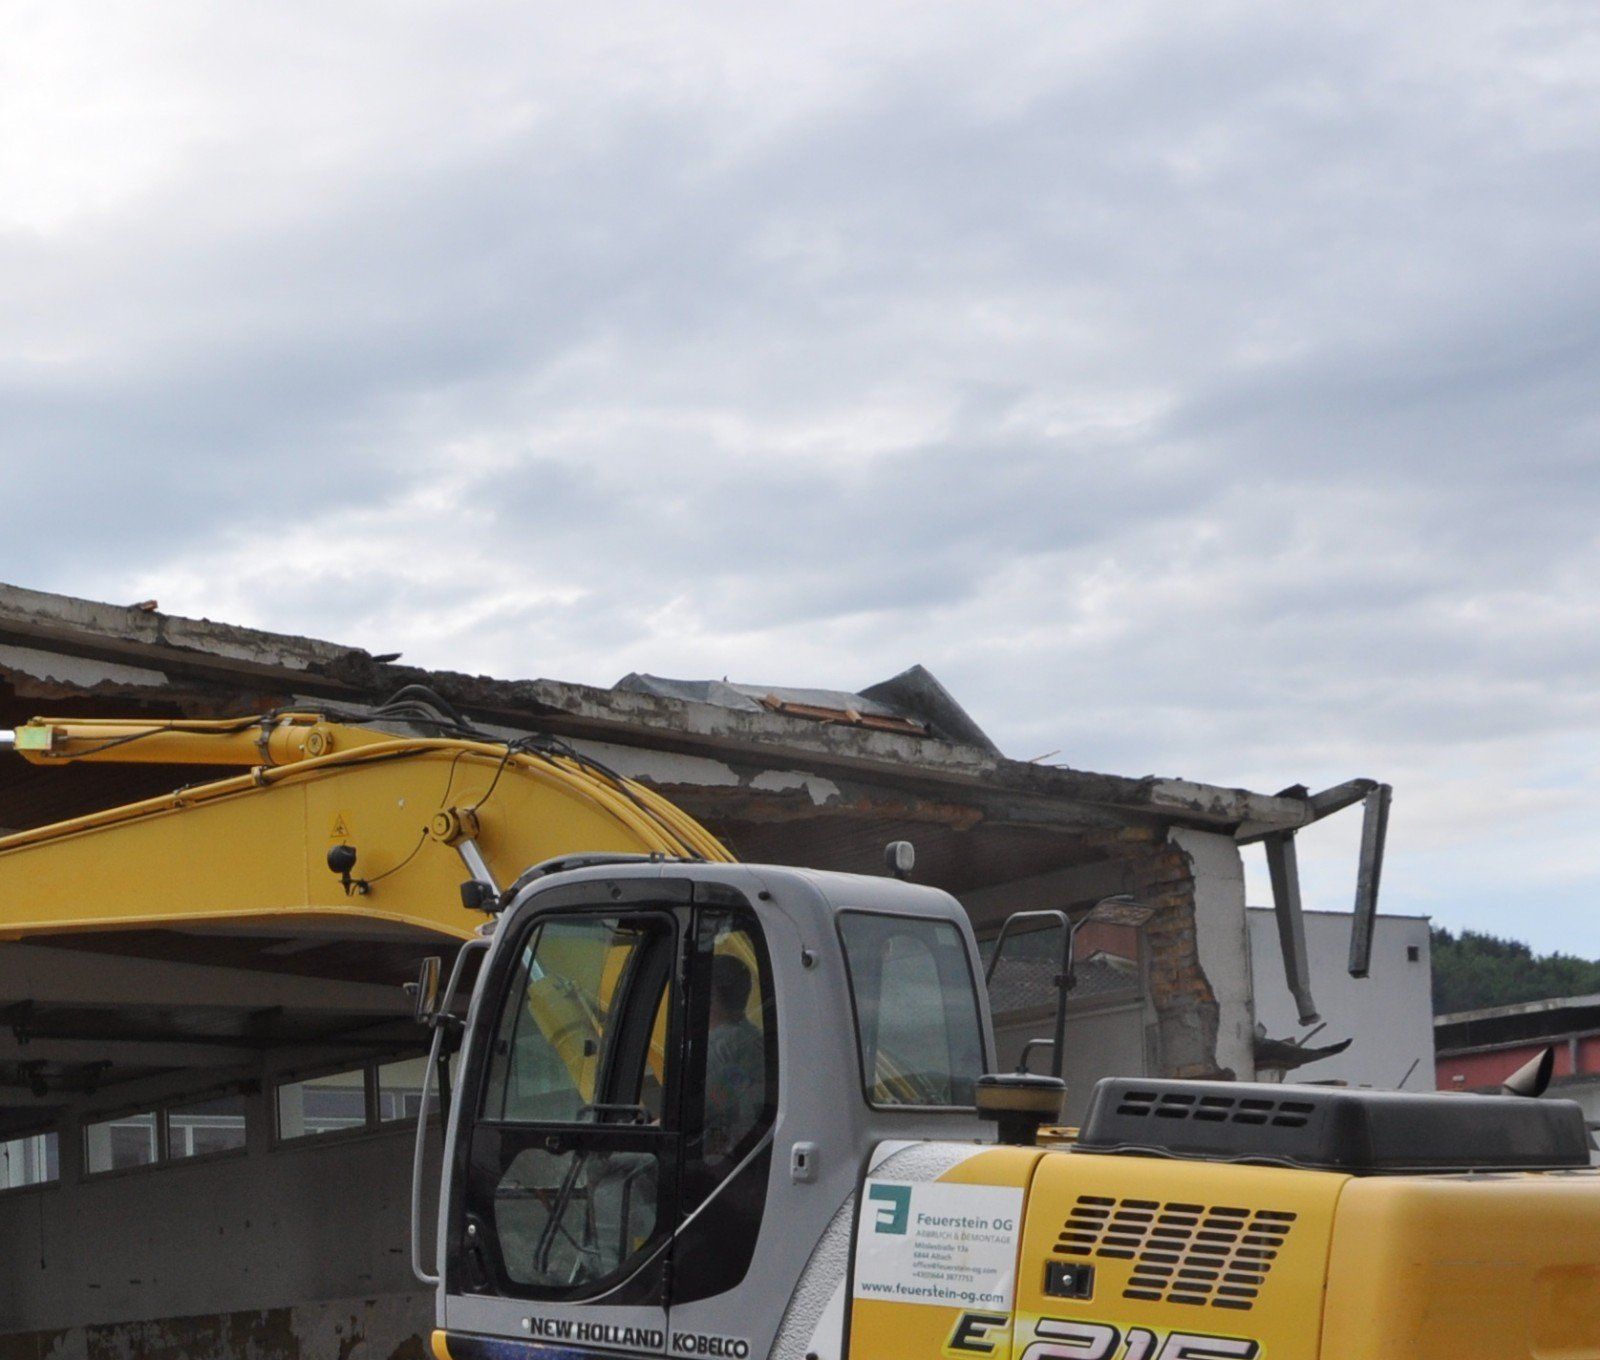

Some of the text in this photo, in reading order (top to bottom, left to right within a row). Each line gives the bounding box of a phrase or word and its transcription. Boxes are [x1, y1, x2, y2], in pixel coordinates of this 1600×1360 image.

[916, 1213, 1013, 1231] Feuerstein OG
[961, 1233, 1011, 1245] DEMONTAGE
[861, 1282, 1004, 1302] www.feuerstein-og.com
[529, 1316, 750, 1360] NEW HOLLAND KOBELCO
[947, 1313, 1010, 1354] E
